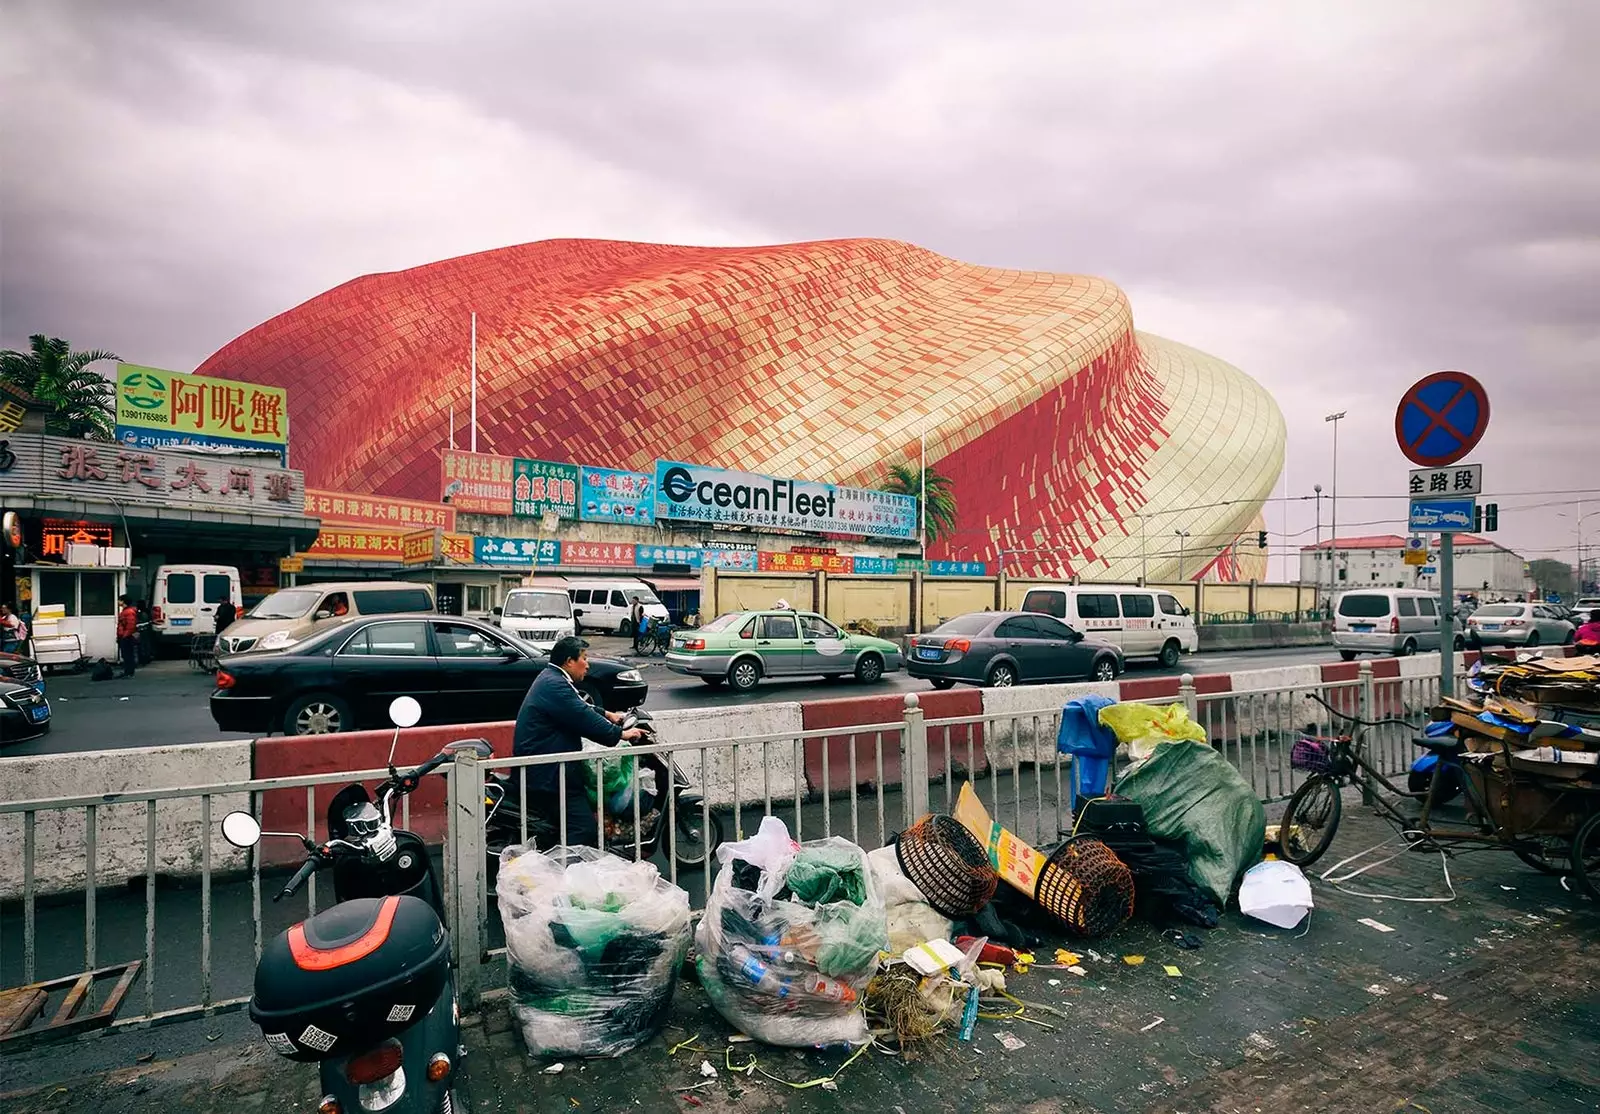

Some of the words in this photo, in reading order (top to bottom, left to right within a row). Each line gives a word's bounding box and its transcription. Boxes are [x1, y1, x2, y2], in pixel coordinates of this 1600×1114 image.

[660, 467, 836, 518] OceanFleet
[1410, 470, 1473, 493] 全路段
